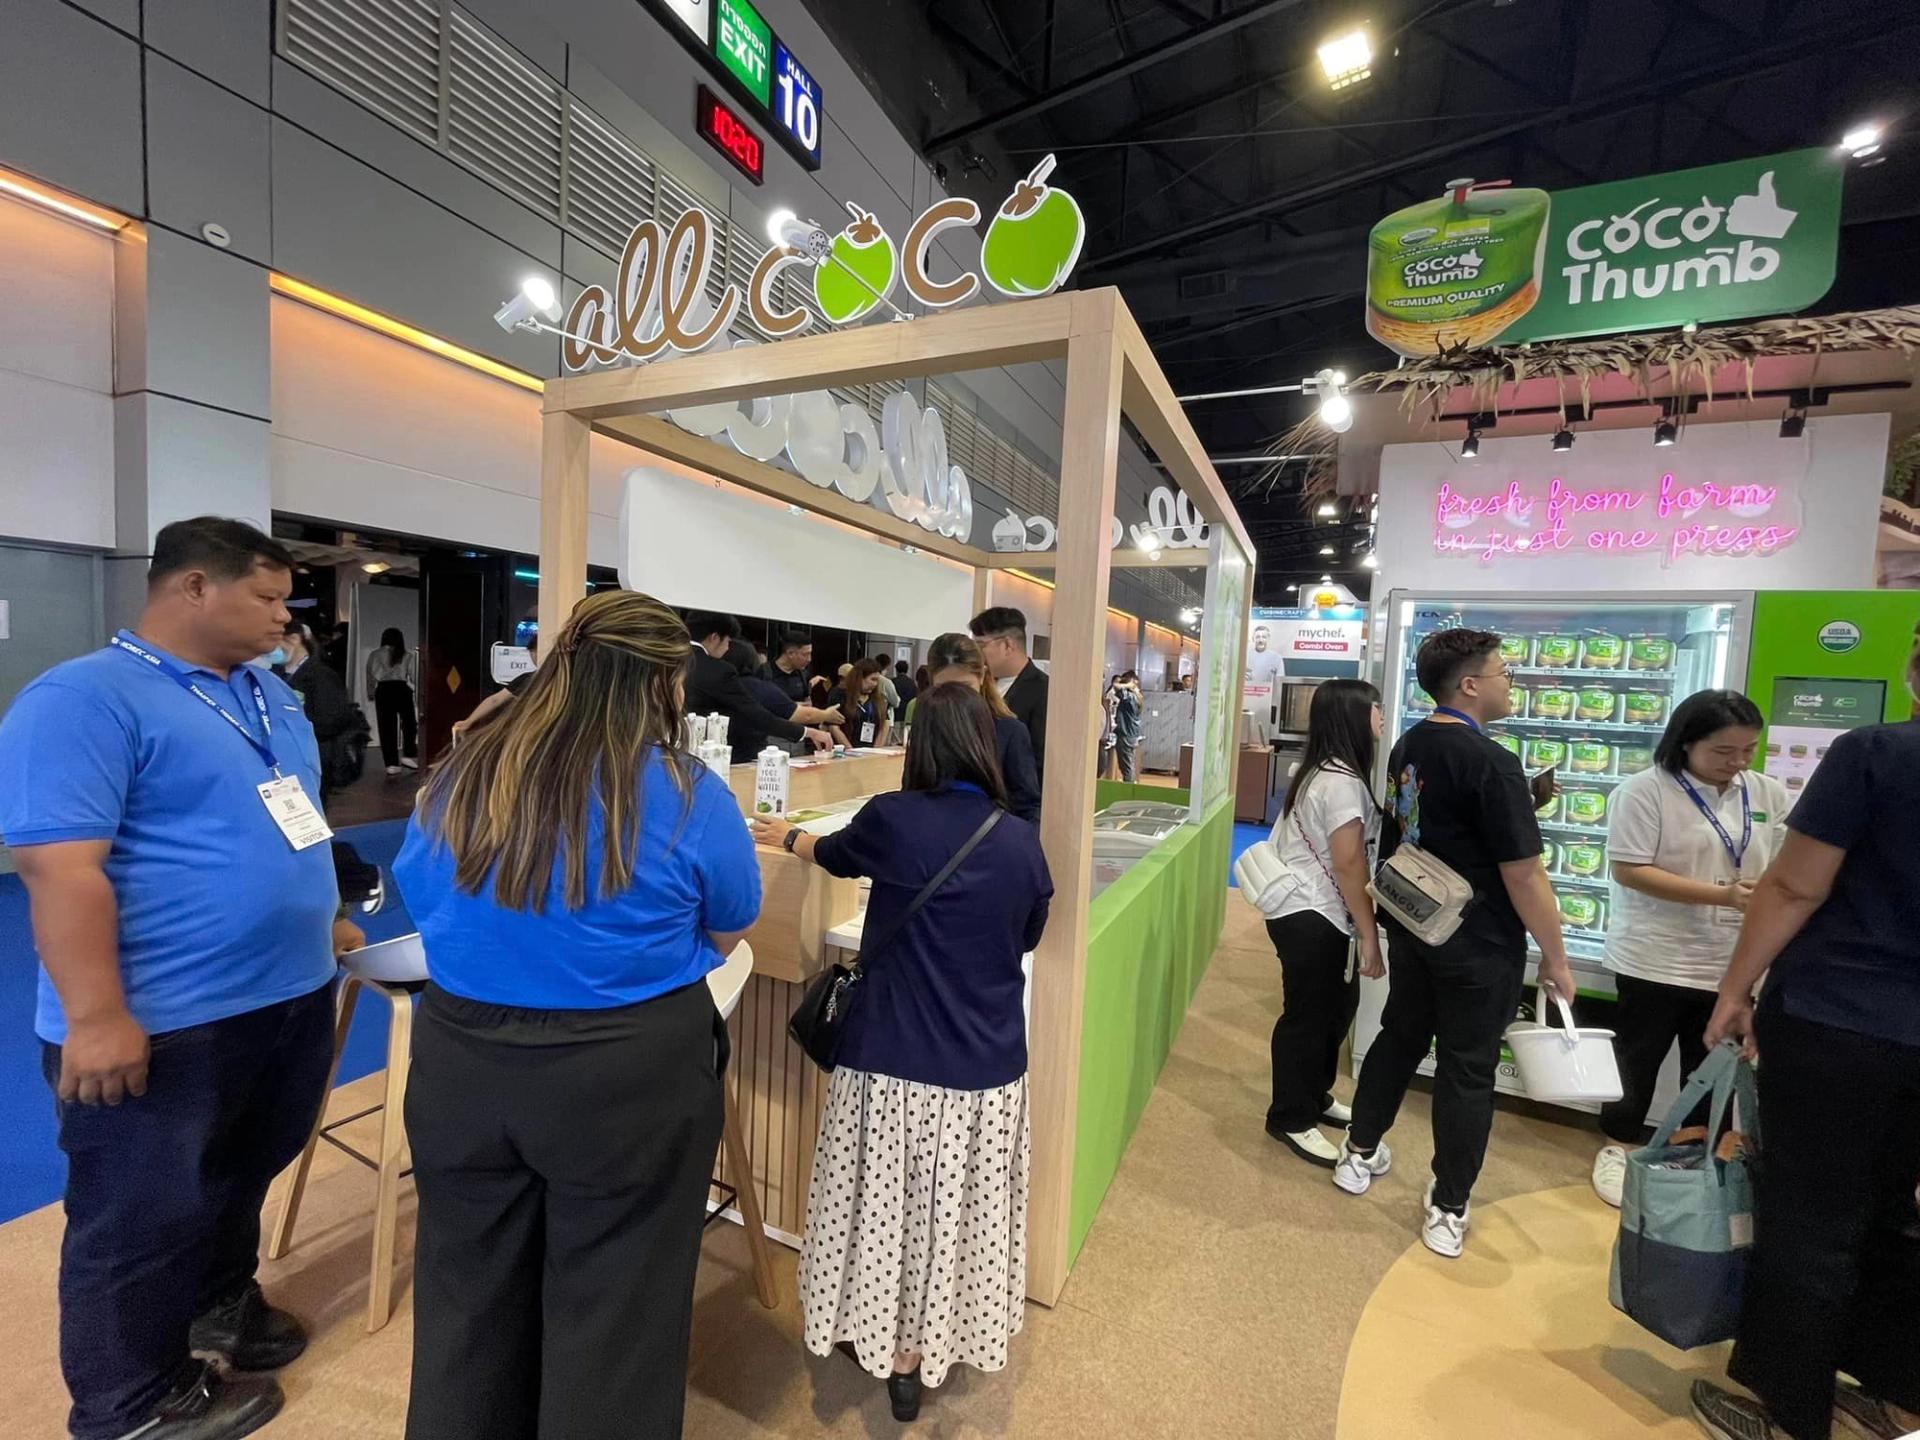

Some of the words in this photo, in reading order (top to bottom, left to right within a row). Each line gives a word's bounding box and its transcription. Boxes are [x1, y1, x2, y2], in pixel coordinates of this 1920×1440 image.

[721, 17, 765, 83] EXIT
[787, 59, 813, 98] HALL
[778, 74, 817, 151] 10
[563, 208, 741, 372] all
[1404, 266, 1478, 287] Thumb
[1562, 240, 1780, 305] Thumb
[1387, 295, 1443, 307] PREMIUM
[1447, 283, 1505, 304] QUALITY
[1436, 481, 1534, 524] fresh
[1547, 479, 1645, 520] from
[1657, 473, 1776, 519] farm
[1436, 529, 1475, 552] in
[1482, 517, 1573, 562] just
[1587, 529, 1657, 550] one
[1671, 526, 1797, 560] press
[511, 662, 527, 670] EXIT
[1299, 641, 1324, 650] Combi
[299, 830, 325, 845] VISITOR
